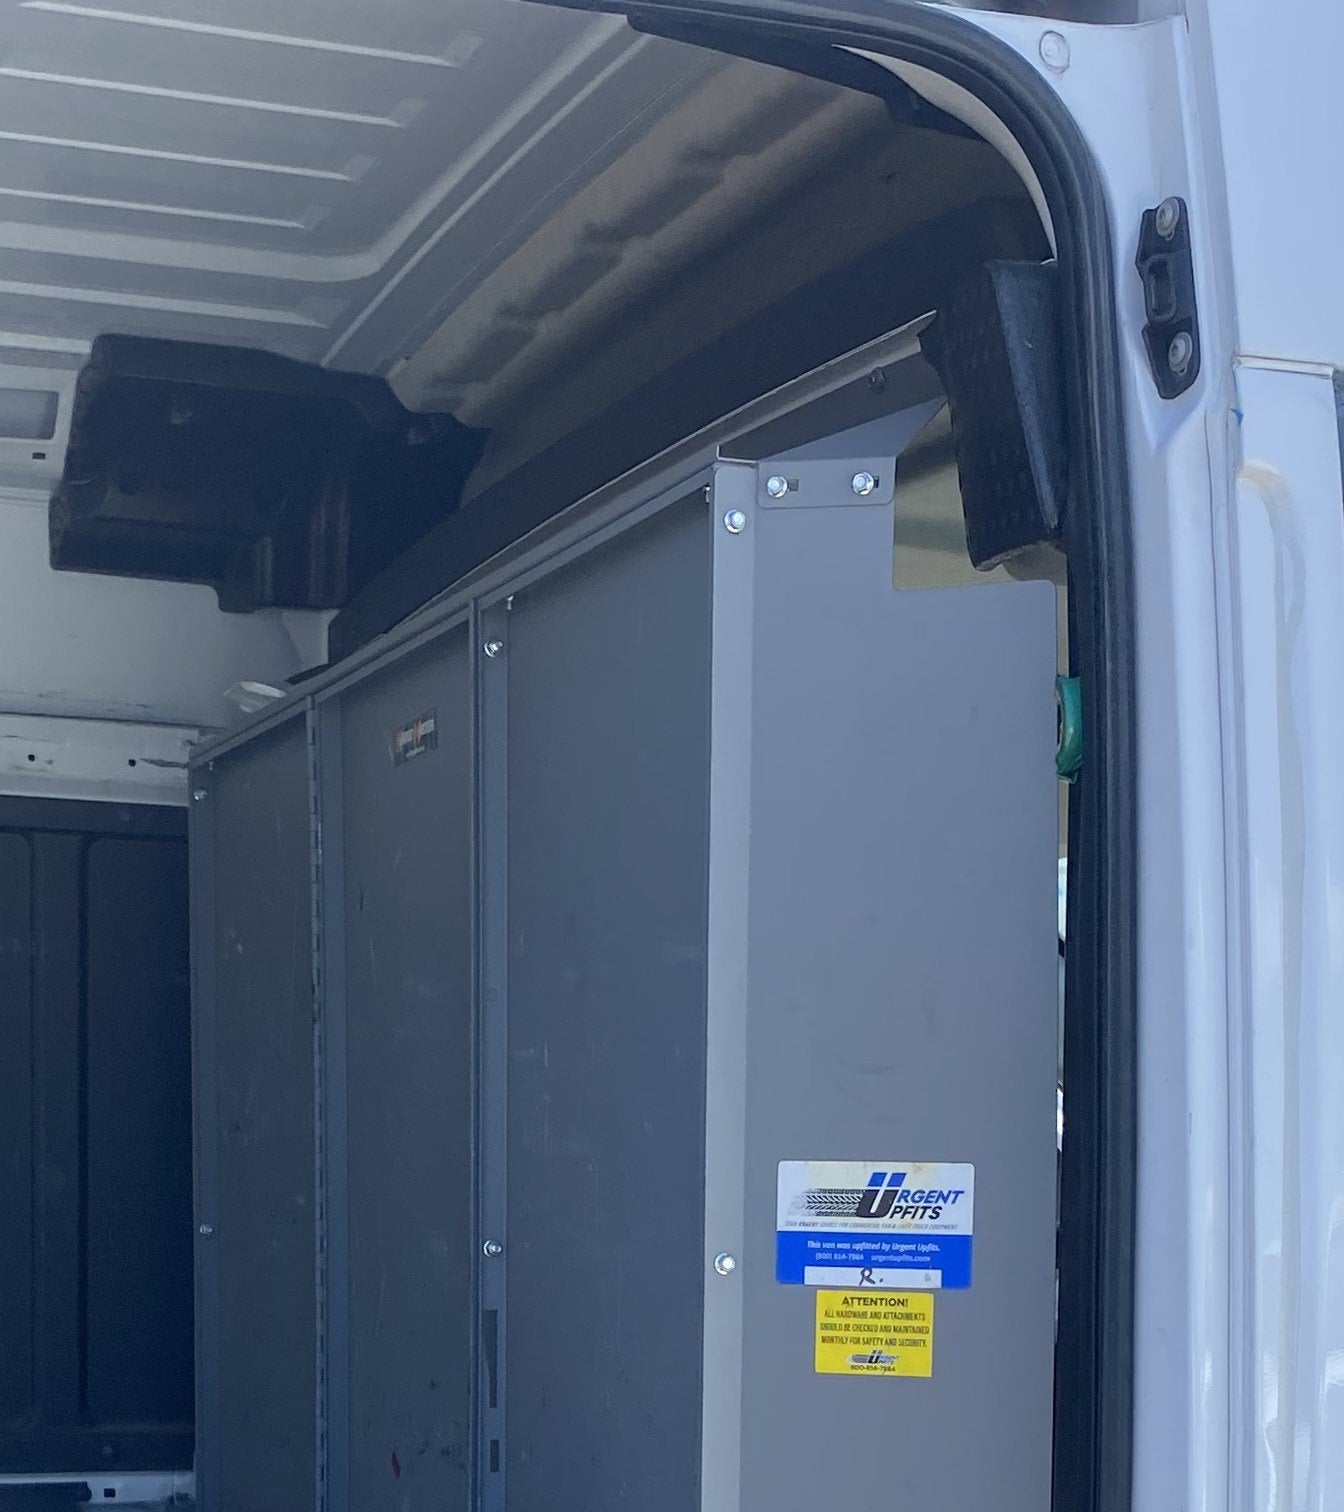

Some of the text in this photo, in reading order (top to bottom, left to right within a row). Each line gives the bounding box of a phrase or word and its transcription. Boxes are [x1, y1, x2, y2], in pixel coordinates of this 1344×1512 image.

[807, 1240, 821, 1249] This
[891, 1242, 917, 1253] Urgent
[841, 1296, 909, 1308] ATTENTION!
[824, 1309, 835, 1318] ALL
